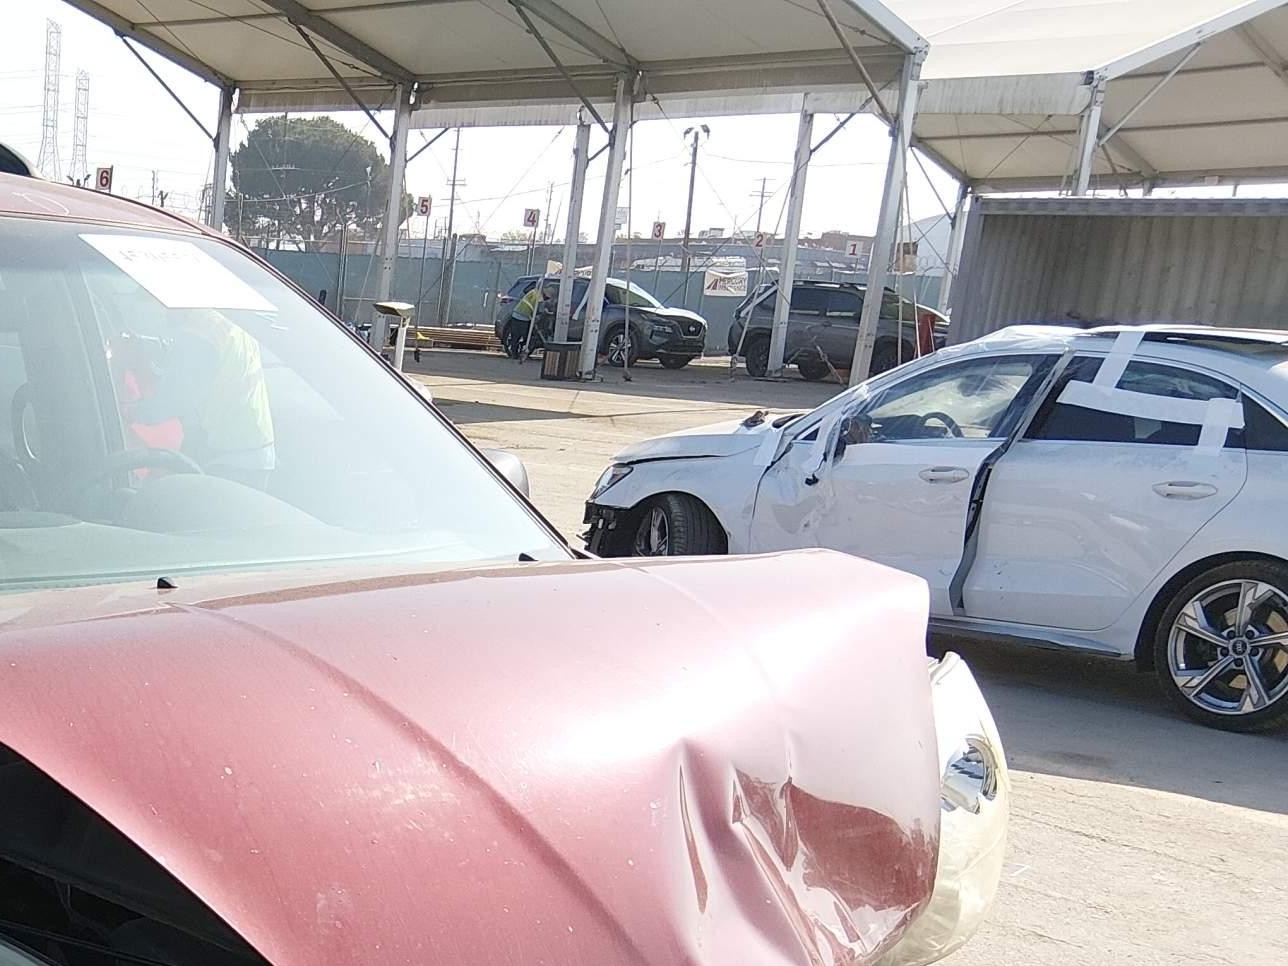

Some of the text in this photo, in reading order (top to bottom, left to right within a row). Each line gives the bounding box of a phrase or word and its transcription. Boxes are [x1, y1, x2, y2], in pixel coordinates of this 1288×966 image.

[99, 169, 110, 188] 6
[420, 199, 429, 215] 5
[527, 210, 537, 226] 4
[654, 223, 663, 238] 3
[755, 233, 764, 248] 2
[848, 243, 858, 256] 1
